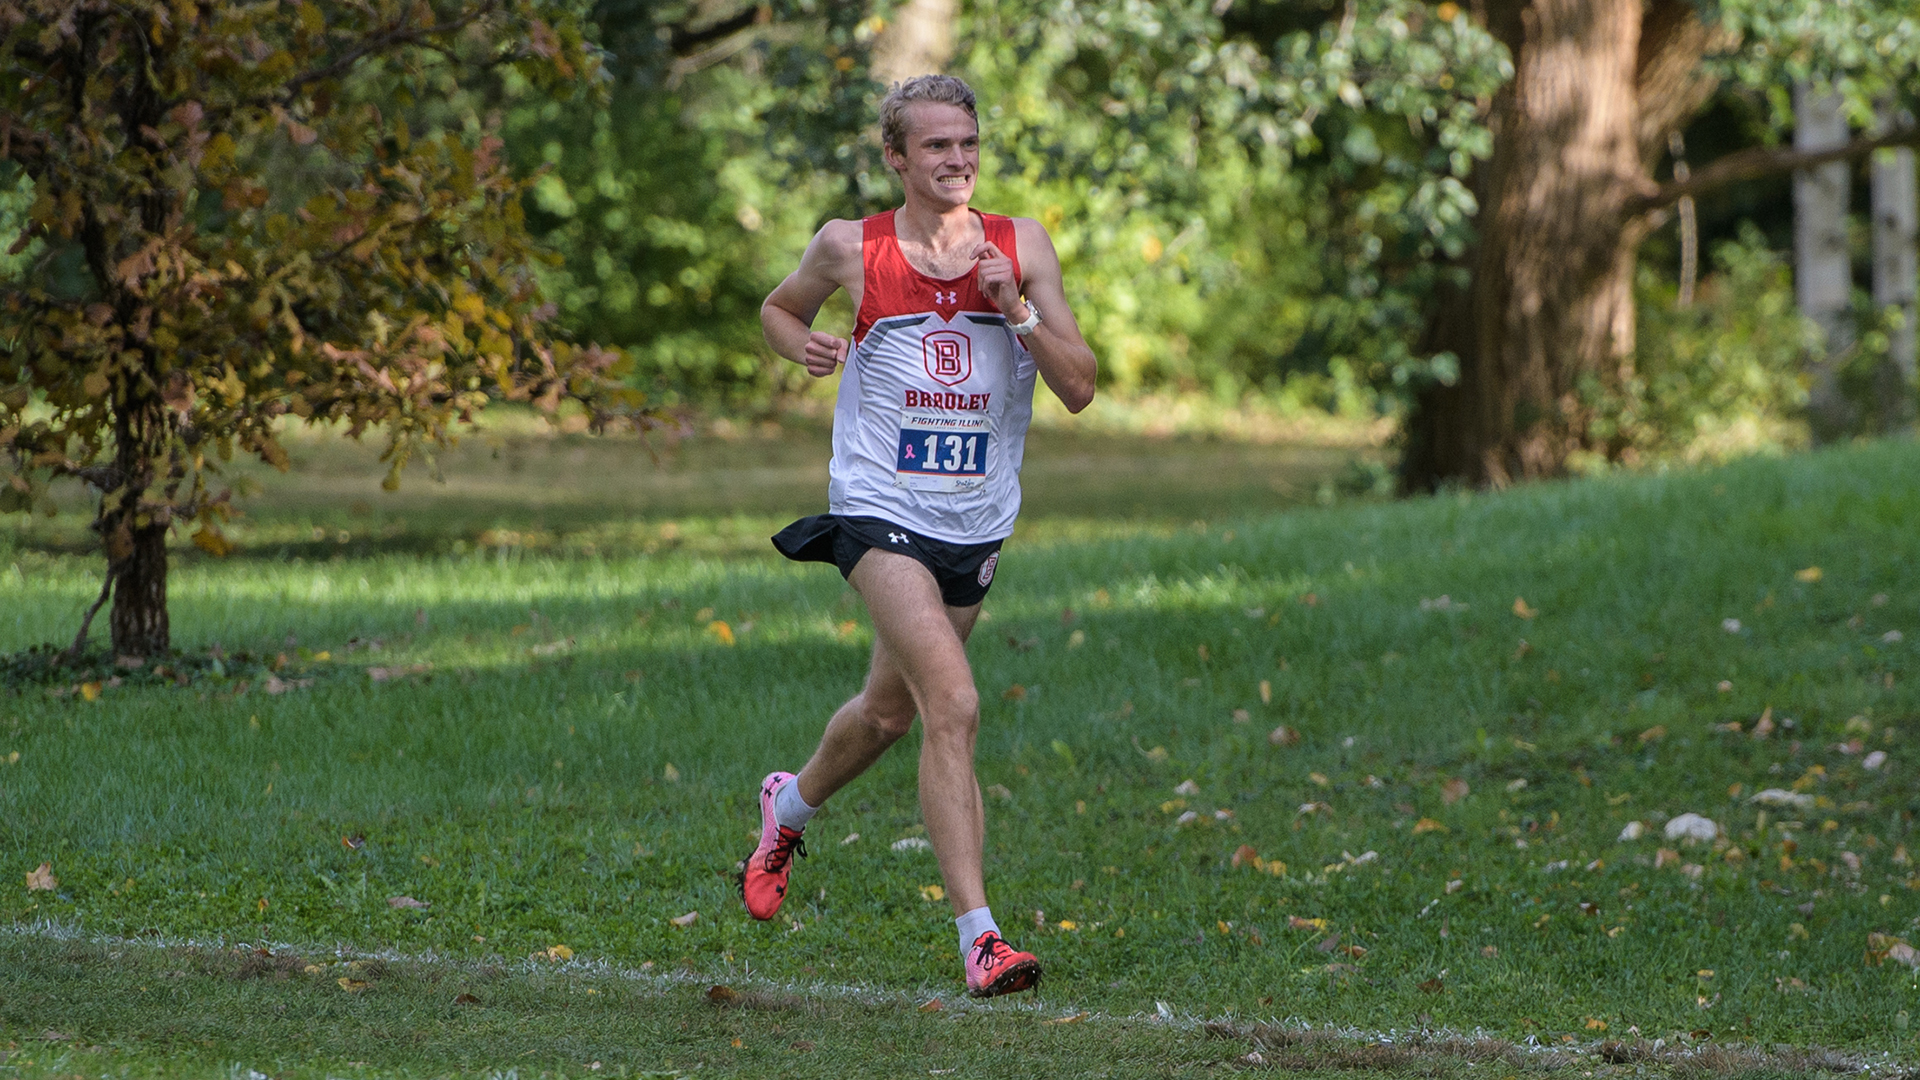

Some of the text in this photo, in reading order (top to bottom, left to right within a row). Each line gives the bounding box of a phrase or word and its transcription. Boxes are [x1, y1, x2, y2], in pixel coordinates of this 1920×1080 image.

[933, 340, 962, 376] B
[905, 390, 991, 410] BRADLEY
[911, 416, 984, 427] FIGHTING ILLINI
[922, 434, 977, 471] 131
